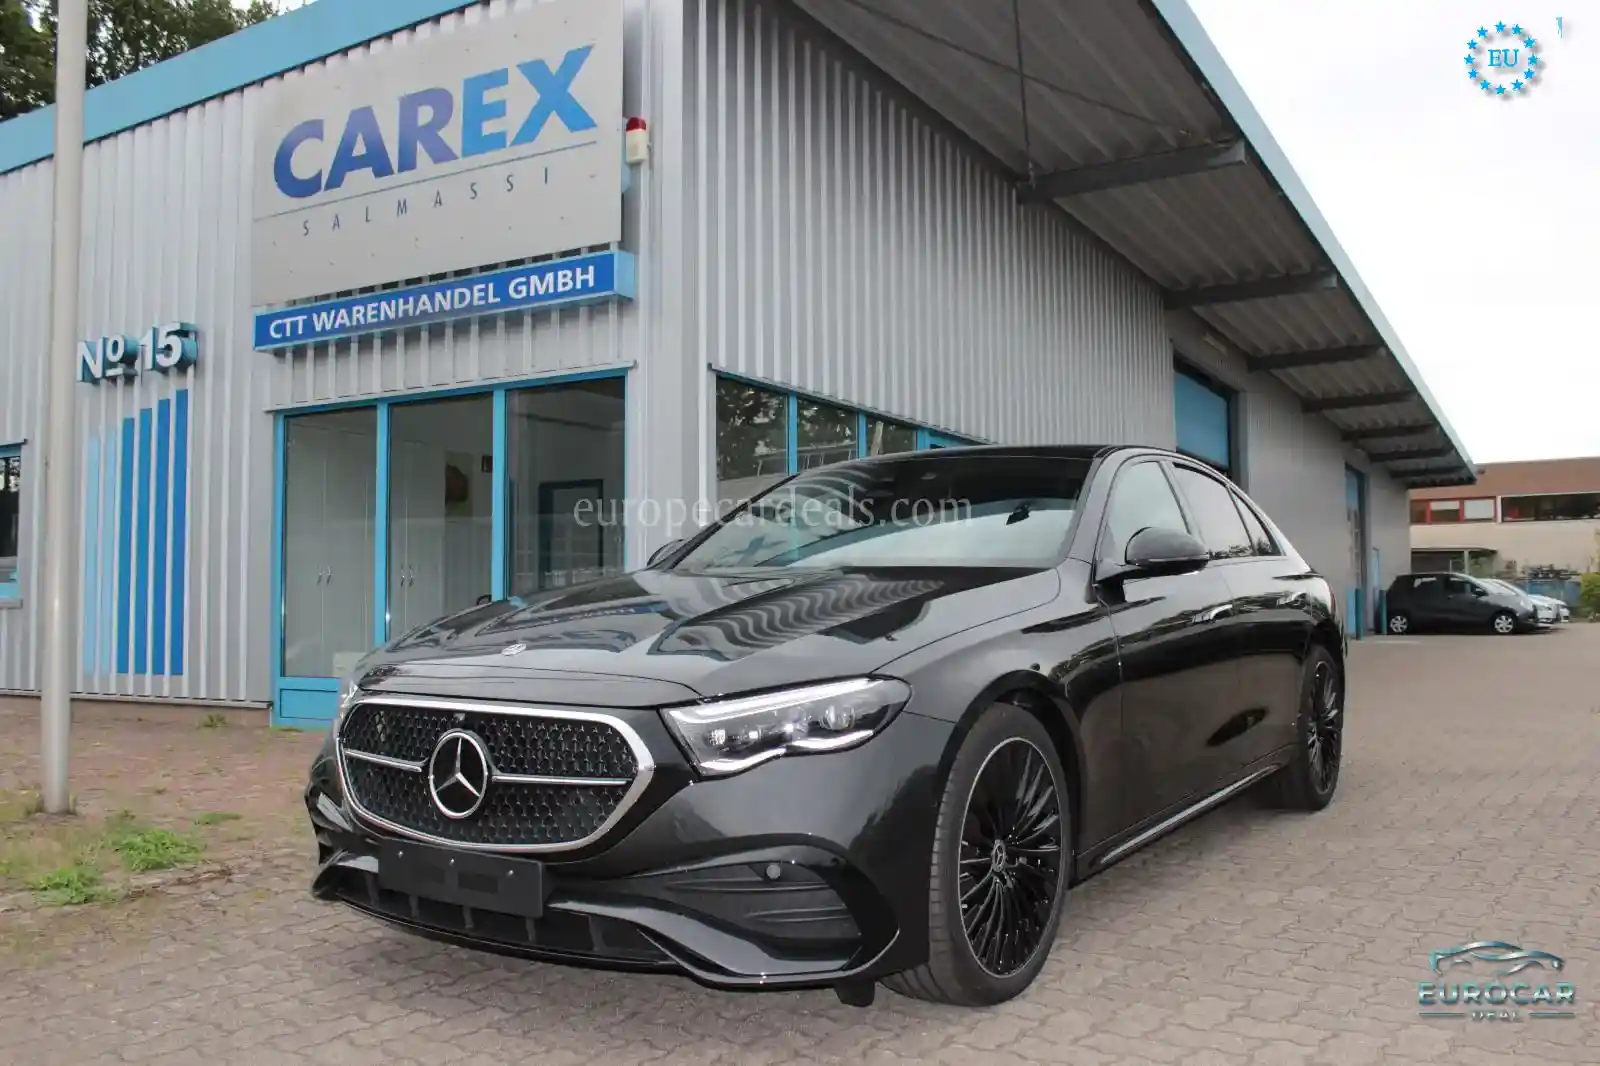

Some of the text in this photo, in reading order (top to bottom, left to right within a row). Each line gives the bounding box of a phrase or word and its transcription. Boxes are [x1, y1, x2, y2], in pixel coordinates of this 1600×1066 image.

[273, 46, 597, 198] CAREX
[302, 167, 549, 236] SALMASSI
[268, 264, 596, 340] CTT WARENHANDEL GMBH
